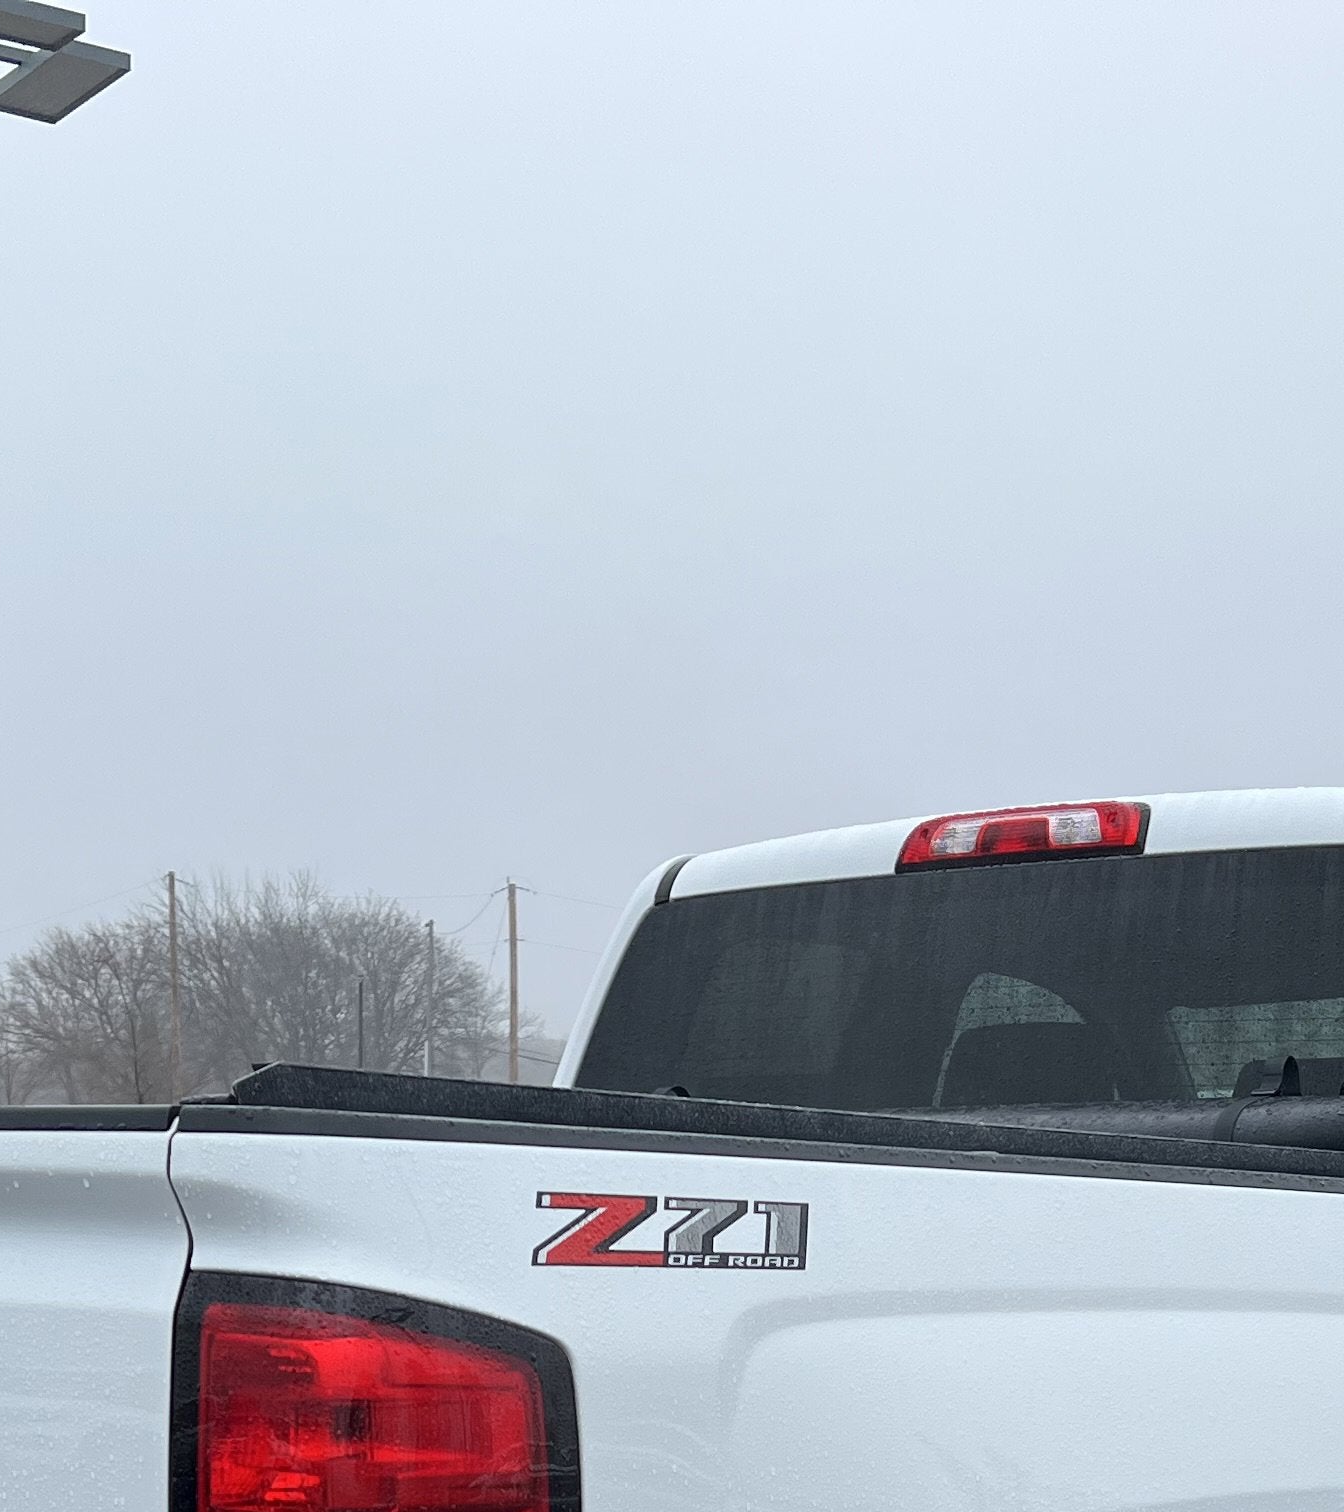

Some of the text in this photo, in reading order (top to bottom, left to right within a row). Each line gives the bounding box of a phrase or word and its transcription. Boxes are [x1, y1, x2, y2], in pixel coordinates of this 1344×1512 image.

[531, 1191, 809, 1270] Z71
[667, 1254, 800, 1268] OFF ROAD
